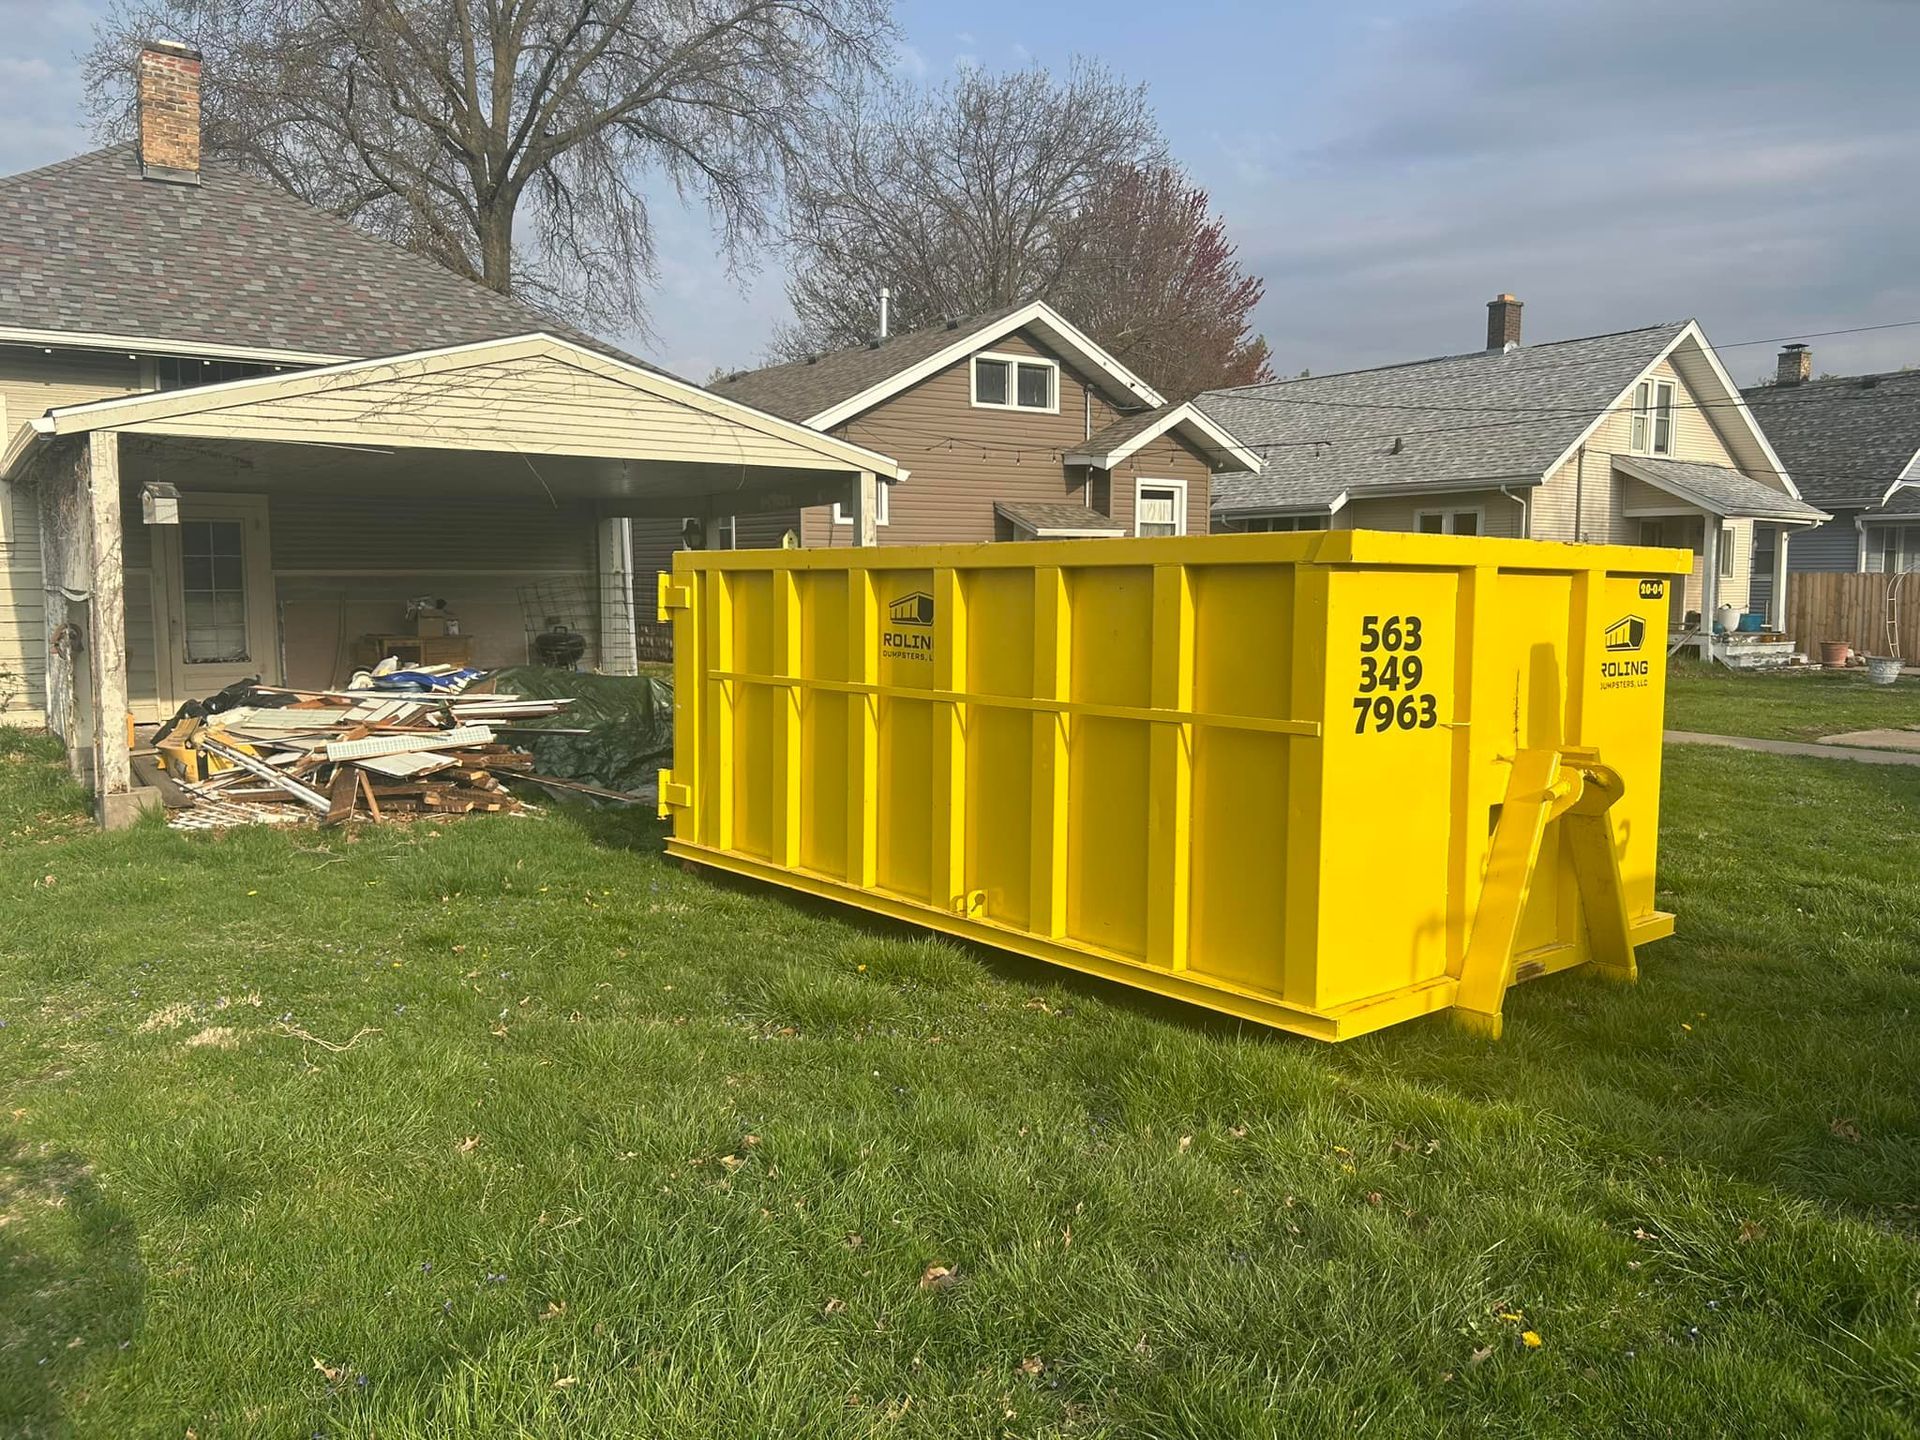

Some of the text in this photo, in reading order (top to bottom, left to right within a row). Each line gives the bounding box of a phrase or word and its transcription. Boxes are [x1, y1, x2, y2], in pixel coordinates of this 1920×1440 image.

[1640, 583, 1663, 595] 20-04
[883, 633, 934, 650] ROLIN
[1360, 616, 1422, 652] 563
[1358, 655, 1423, 693] 349
[1353, 693, 1438, 734] 7963
